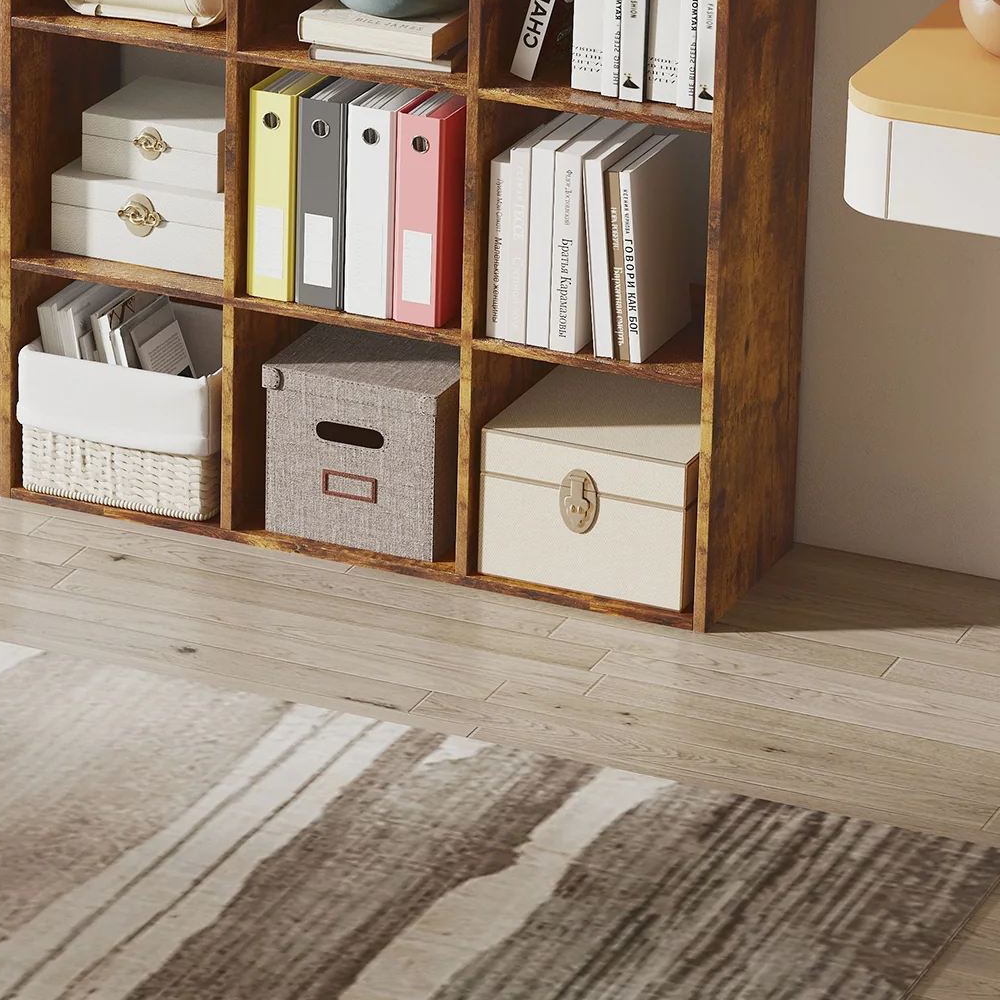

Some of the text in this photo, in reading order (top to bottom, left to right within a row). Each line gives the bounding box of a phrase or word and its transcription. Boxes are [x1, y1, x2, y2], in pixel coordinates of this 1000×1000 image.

[385, 21, 423, 31] JAMES
[494, 237, 502, 282] Маленькие
[558, 238, 573, 273] Братья
[625, 239, 635, 288] ГОВОРИ
[492, 283, 500, 324] женщины
[556, 276, 571, 338] Карамазовы
[612, 267, 623, 314] Бархатная
[628, 292, 636, 311] КАК
[614, 315, 624, 346] смерть
[629, 316, 638, 335] БОГ
